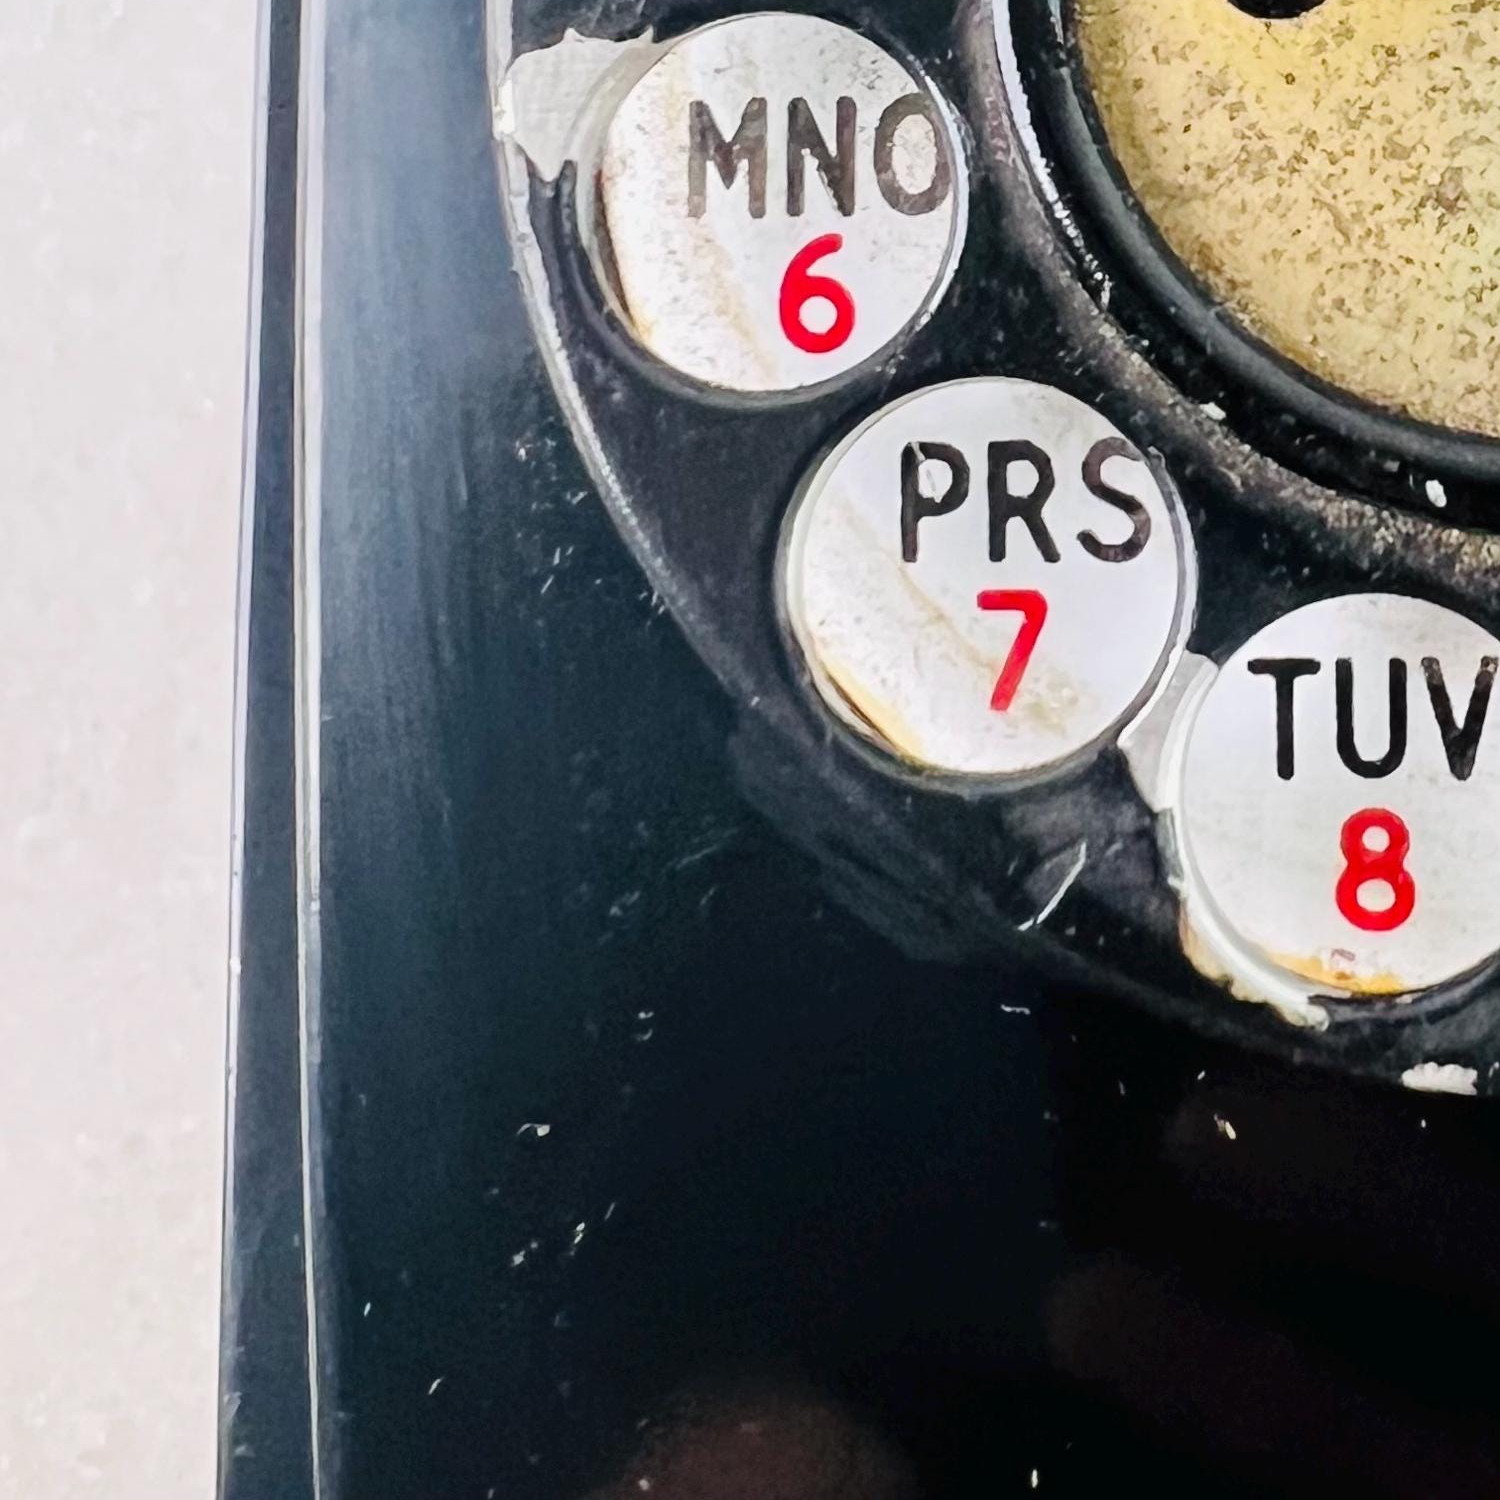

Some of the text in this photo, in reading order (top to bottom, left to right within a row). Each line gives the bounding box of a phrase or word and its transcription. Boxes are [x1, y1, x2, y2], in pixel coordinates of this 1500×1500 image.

[689, 96, 952, 219] MNO
[777, 232, 856, 355] 6
[900, 436, 1151, 564] PRS
[976, 588, 1049, 713] 7
[1247, 655, 1499, 782] TUV
[1334, 807, 1417, 933] 8
